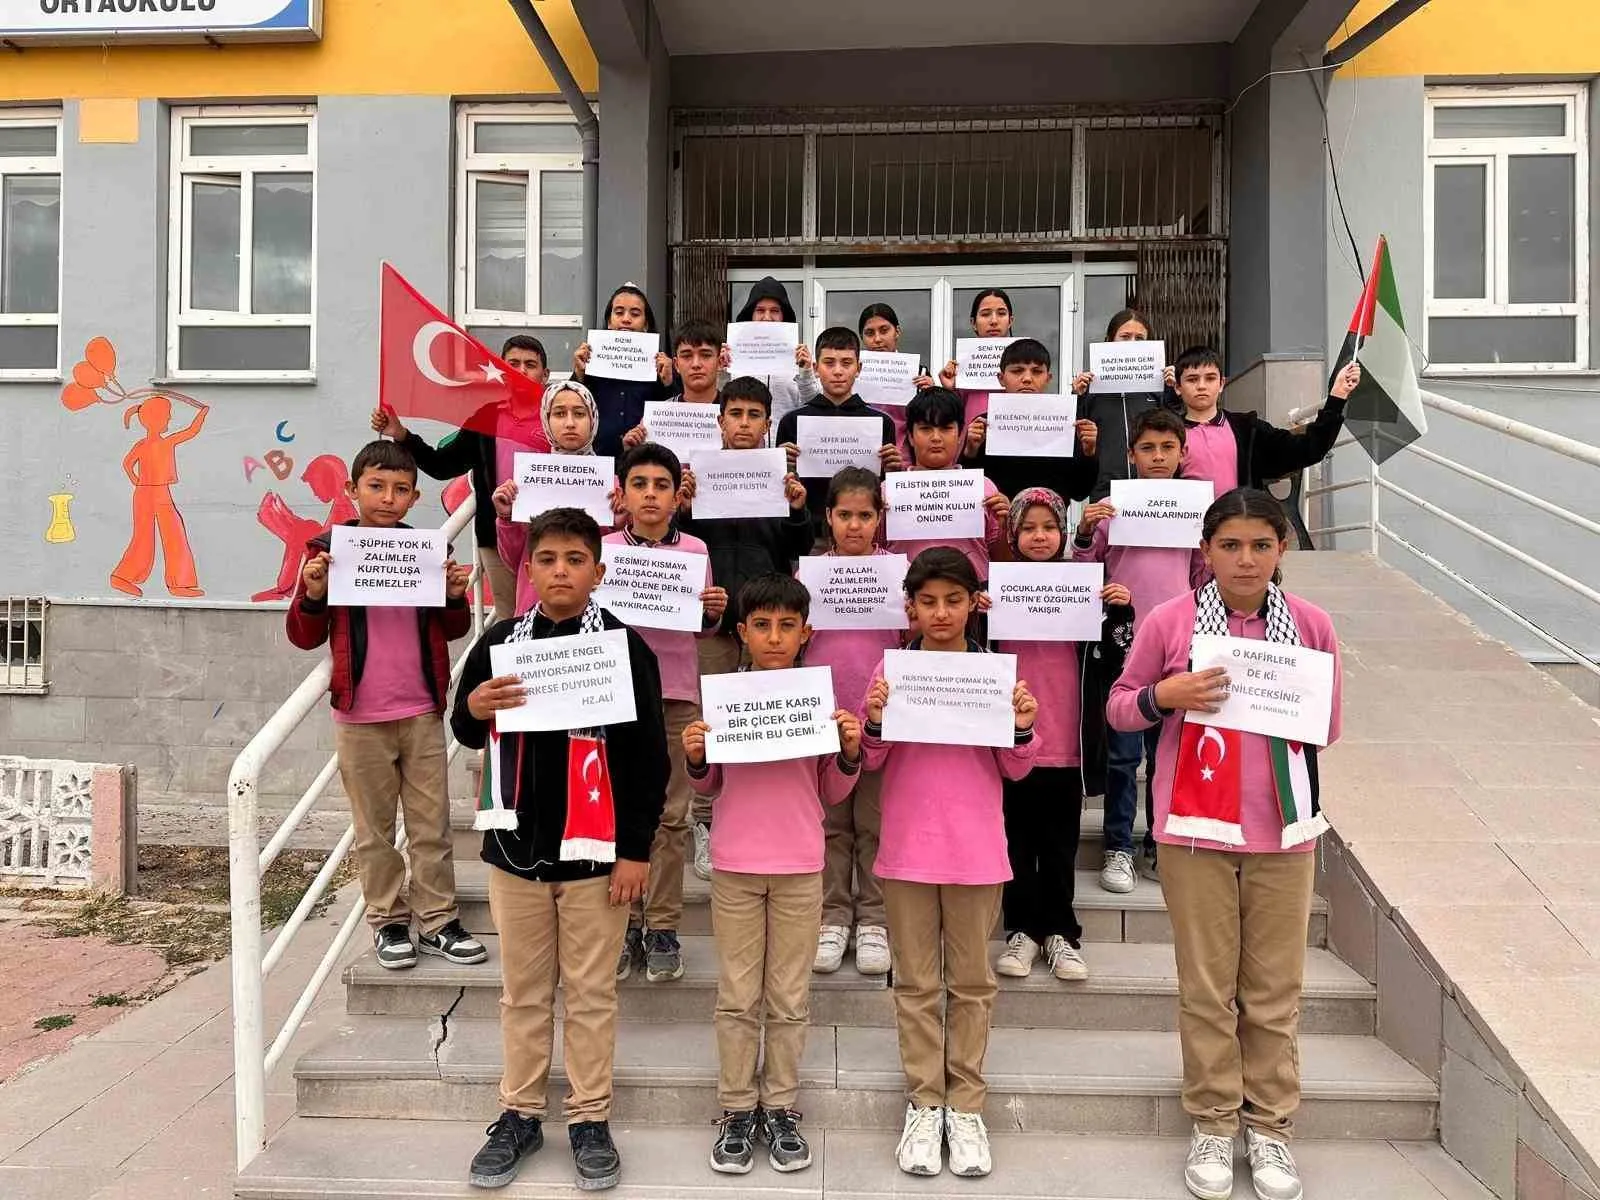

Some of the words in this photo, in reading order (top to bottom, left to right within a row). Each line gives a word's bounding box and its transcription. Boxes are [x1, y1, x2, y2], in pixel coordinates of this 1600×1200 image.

[531, 464, 560, 472] SEFER
[524, 476, 553, 484] ZAFER
[555, 478, 604, 486] ALLAH'TAN
[896, 480, 930, 488] FİLİSTİN
[712, 482, 738, 491] ÖZGÜR
[915, 503, 943, 511] MÜMİN
[917, 514, 952, 522] ÖNÜNDE
[397, 540, 419, 549] YOK
[364, 552, 416, 562] ZALİMLER
[358, 565, 420, 575] KURTULUŞA
[652, 560, 687, 571] KISMAYA
[829, 577, 878, 585] ZALİMLERİN
[631, 580, 659, 591] ÖLENE
[662, 584, 679, 592] DEK
[681, 586, 693, 594] BU
[1000, 585, 1053, 593] ÇOCUKLARA
[1055, 584, 1091, 593] GÜLMEK
[633, 592, 662, 601] DAVAYI
[846, 596, 886, 604] HABERSİZ
[1044, 594, 1090, 603] ÖZGÜRLÜK
[516, 654, 533, 665] BİR
[536, 650, 570, 663] ZULME
[572, 645, 604, 657] ENGEL
[1243, 650, 1297, 667] KAFİRLERE
[593, 660, 616, 670] ONU
[1247, 668, 1260, 679] DE
[1263, 671, 1277, 681] Kİ:
[528, 683, 559, 696] RKESE
[562, 678, 612, 692] DUYURUN
[726, 704, 740, 713] VE
[744, 700, 783, 712] ZULME
[786, 696, 820, 709] KARŞI
[906, 695, 936, 706] İNSAN
[728, 717, 748, 728] BİR
[789, 710, 812, 722] GİBİ
[716, 730, 763, 743] DİRENİR
[766, 730, 782, 739] BU
